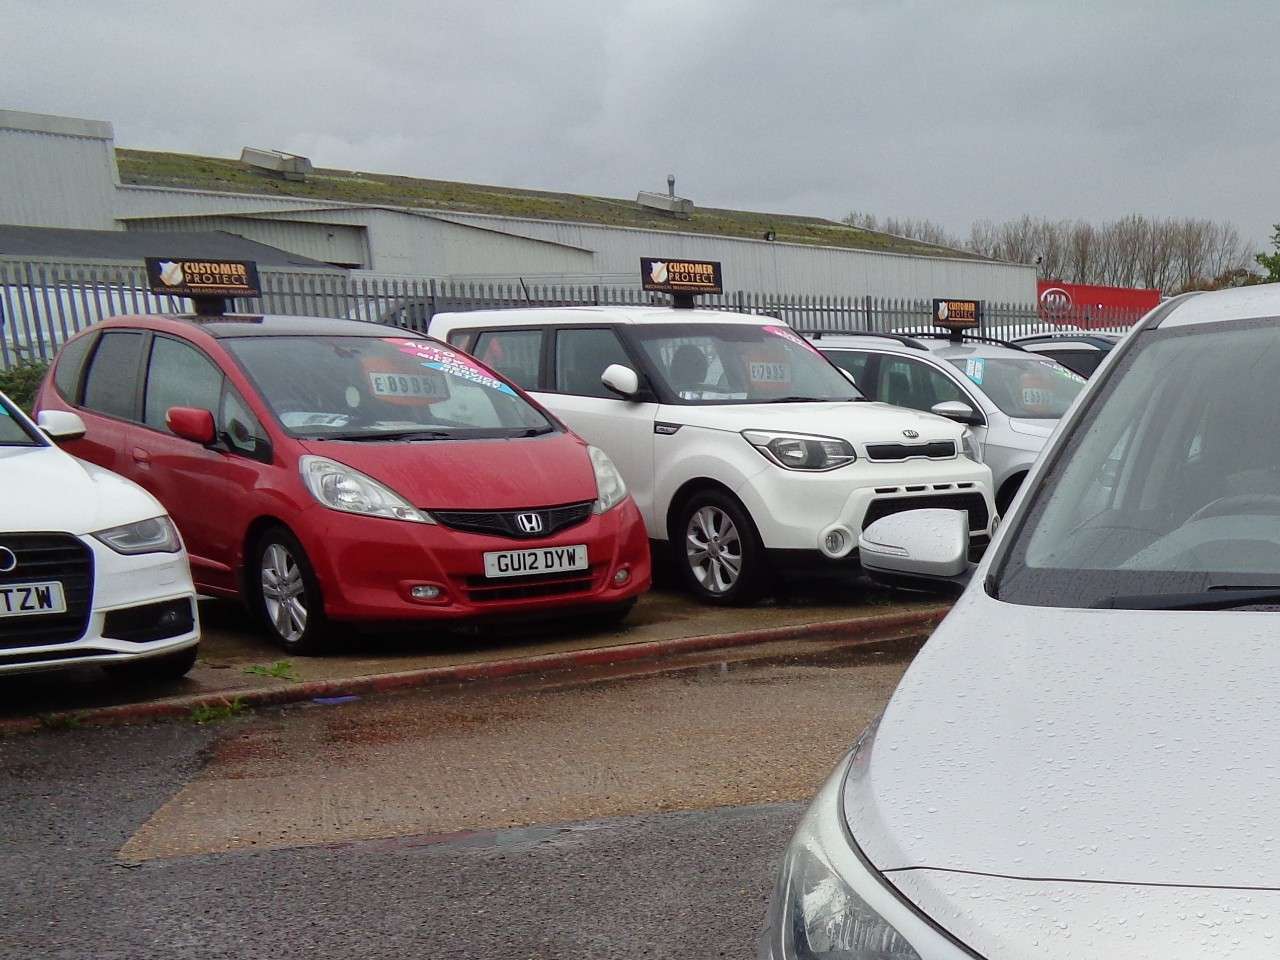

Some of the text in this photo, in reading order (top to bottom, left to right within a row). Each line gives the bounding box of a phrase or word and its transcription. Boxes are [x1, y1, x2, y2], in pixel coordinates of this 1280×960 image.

[183, 262, 246, 275] CUSTOMER
[668, 262, 713, 274] CUSTOMER
[185, 273, 248, 284] PROTECT
[669, 272, 714, 283] PROTECT
[949, 302, 976, 311] CUSTOMER
[404, 341, 455, 358] AUTO
[497, 548, 576, 572] GU12 DYW
[0, 586, 52, 611] TZW
